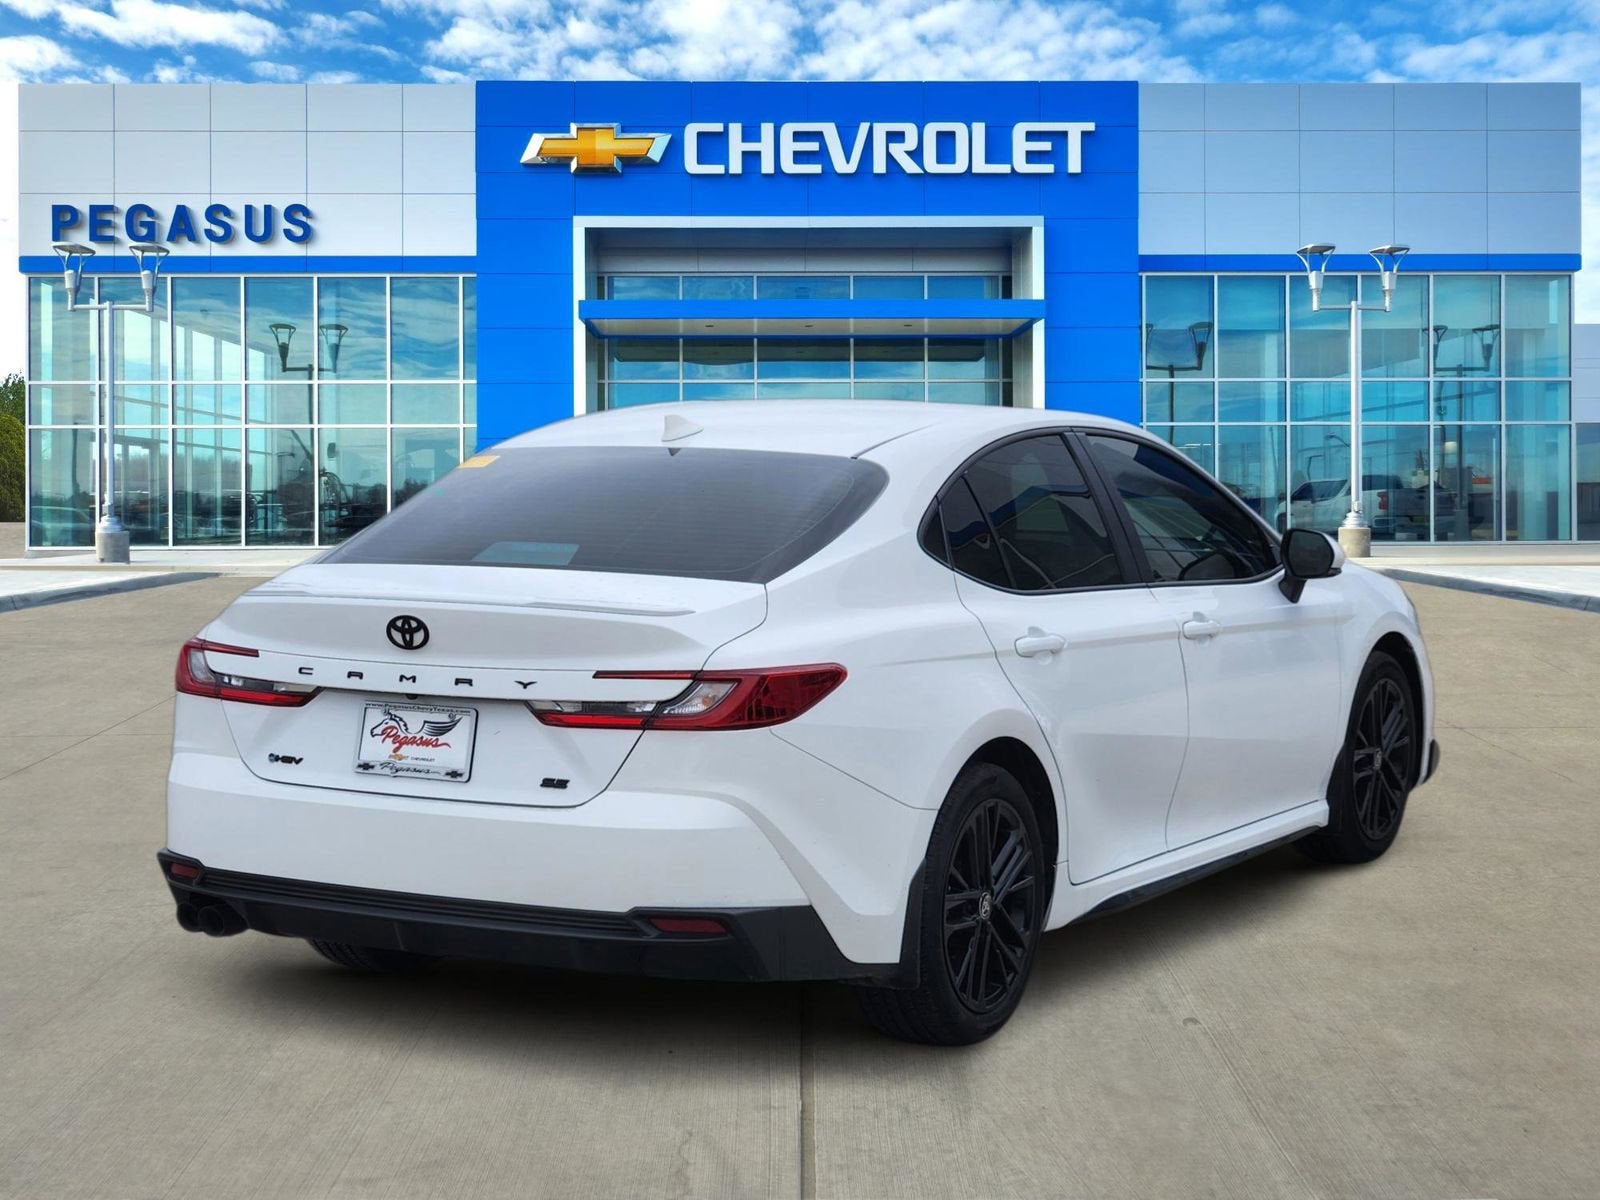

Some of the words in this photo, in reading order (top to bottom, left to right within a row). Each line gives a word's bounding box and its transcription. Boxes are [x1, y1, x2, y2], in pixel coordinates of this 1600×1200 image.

[684, 122, 1096, 175] CHEVROLET
[51, 203, 314, 244] PEGASUS
[298, 666, 537, 690] CAMRY
[381, 725, 452, 754] Pegasus
[379, 761, 441, 775] Pegasus
[539, 777, 571, 790] SE
